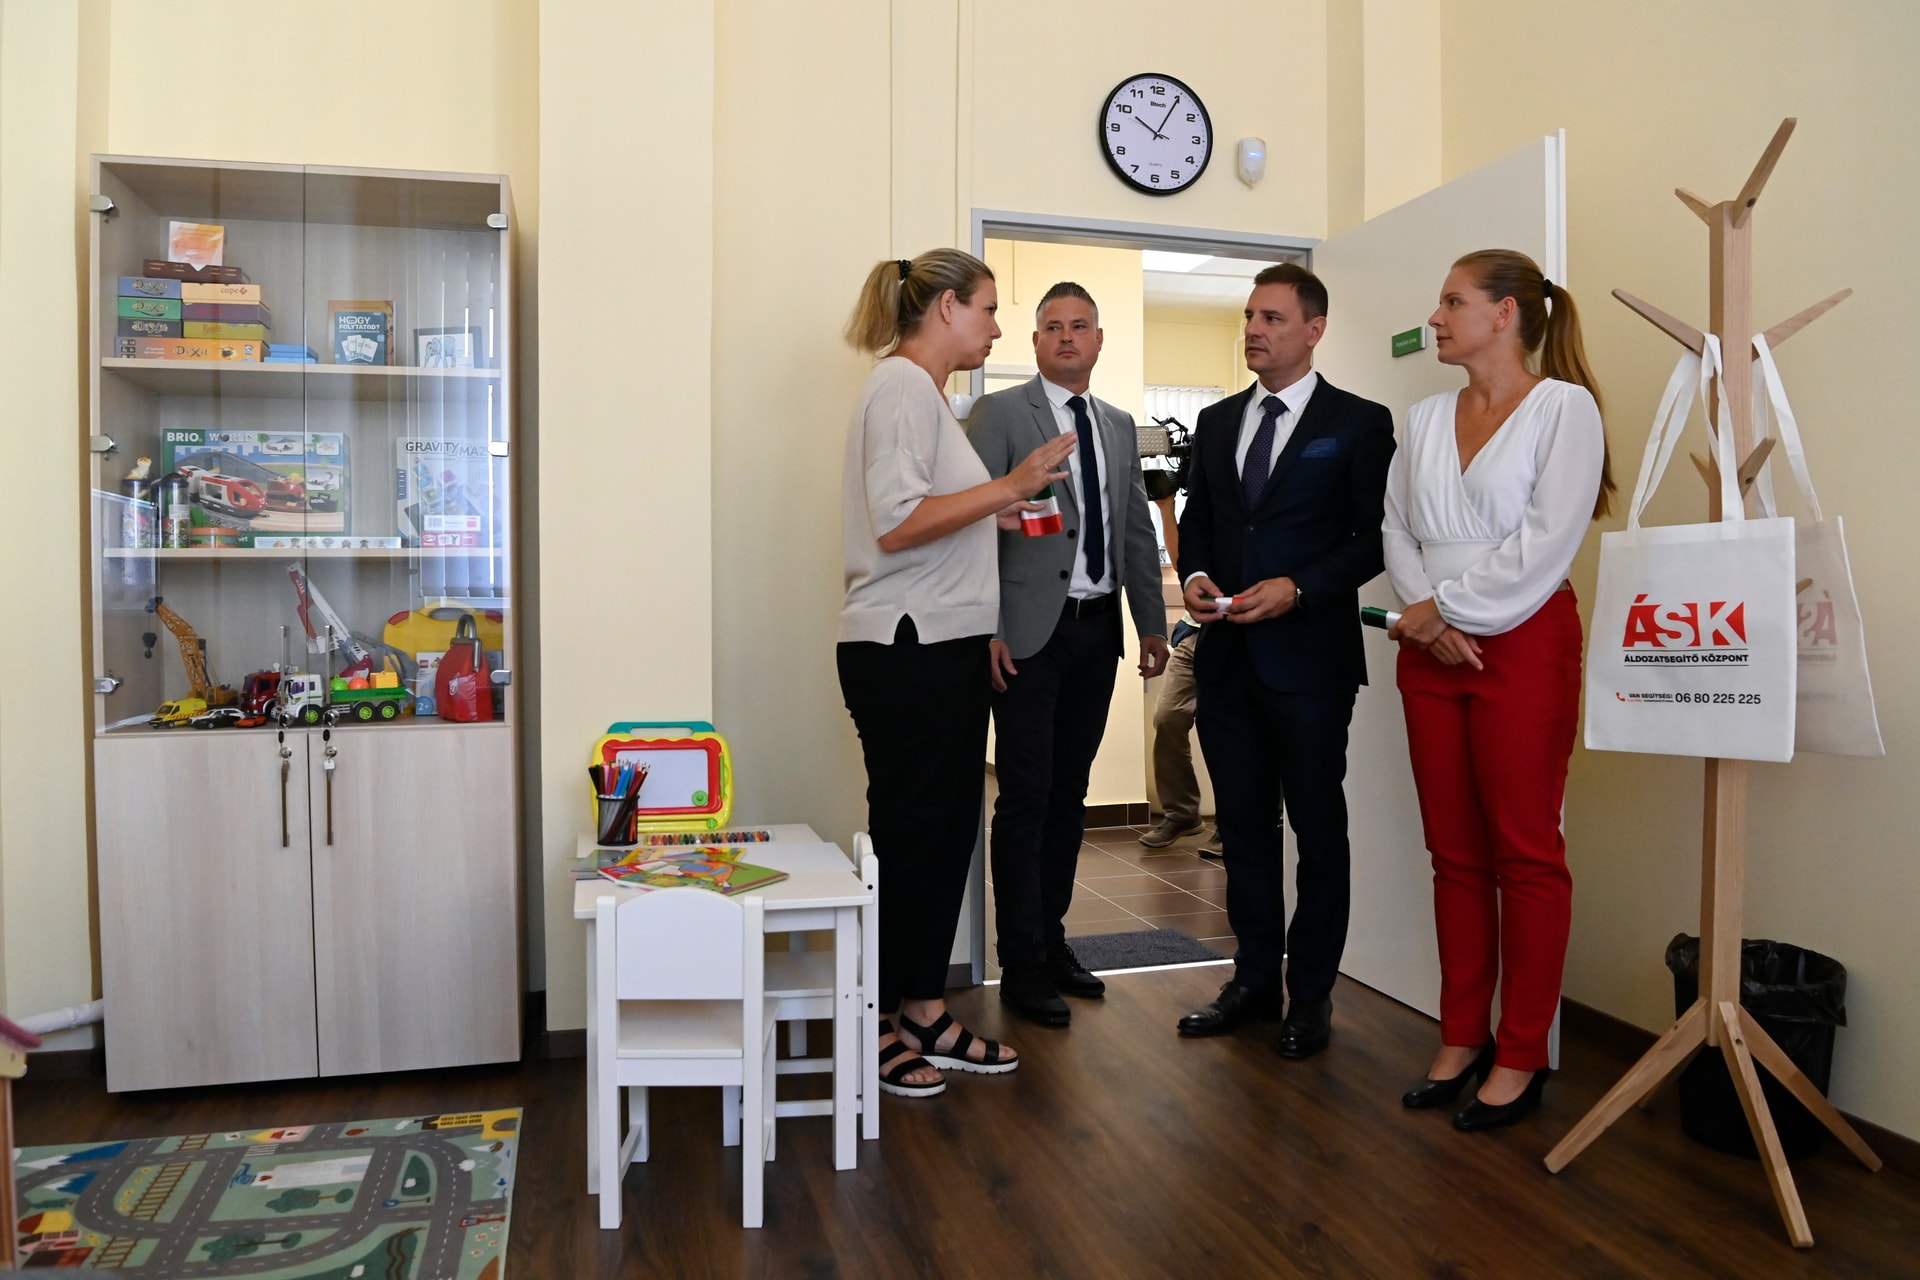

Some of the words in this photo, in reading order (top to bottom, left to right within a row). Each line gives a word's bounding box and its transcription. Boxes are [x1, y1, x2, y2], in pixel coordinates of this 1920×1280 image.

[1130, 88, 1144, 99] 11
[1150, 85, 1166, 95] 12
[1174, 95, 1180, 104] 1
[1115, 103, 1133, 114] 10
[1186, 113, 1196, 123] 2
[1111, 123, 1120, 132] 9
[1191, 135, 1201, 145] 3
[1116, 146, 1126, 155] 8
[1185, 155, 1195, 165] 4
[1130, 164, 1140, 174] 7
[1150, 174, 1160, 184] 6
[1170, 170, 1180, 179] 5
[166, 432, 200, 442] BRIO
[209, 432, 253, 443] WORLD
[405, 441, 460, 455] GRAVITY
[460, 445, 489, 457] MAZ
[1622, 593, 1747, 648] ÁSK
[1624, 653, 1699, 663] ÁLDOZATSEGÍTŐ
[1701, 653, 1749, 662] KÖZPONT
[1675, 692, 1692, 703] 06
[1694, 693, 1710, 703] 80
[1712, 693, 1736, 704] 225
[1738, 693, 1761, 704] 225
